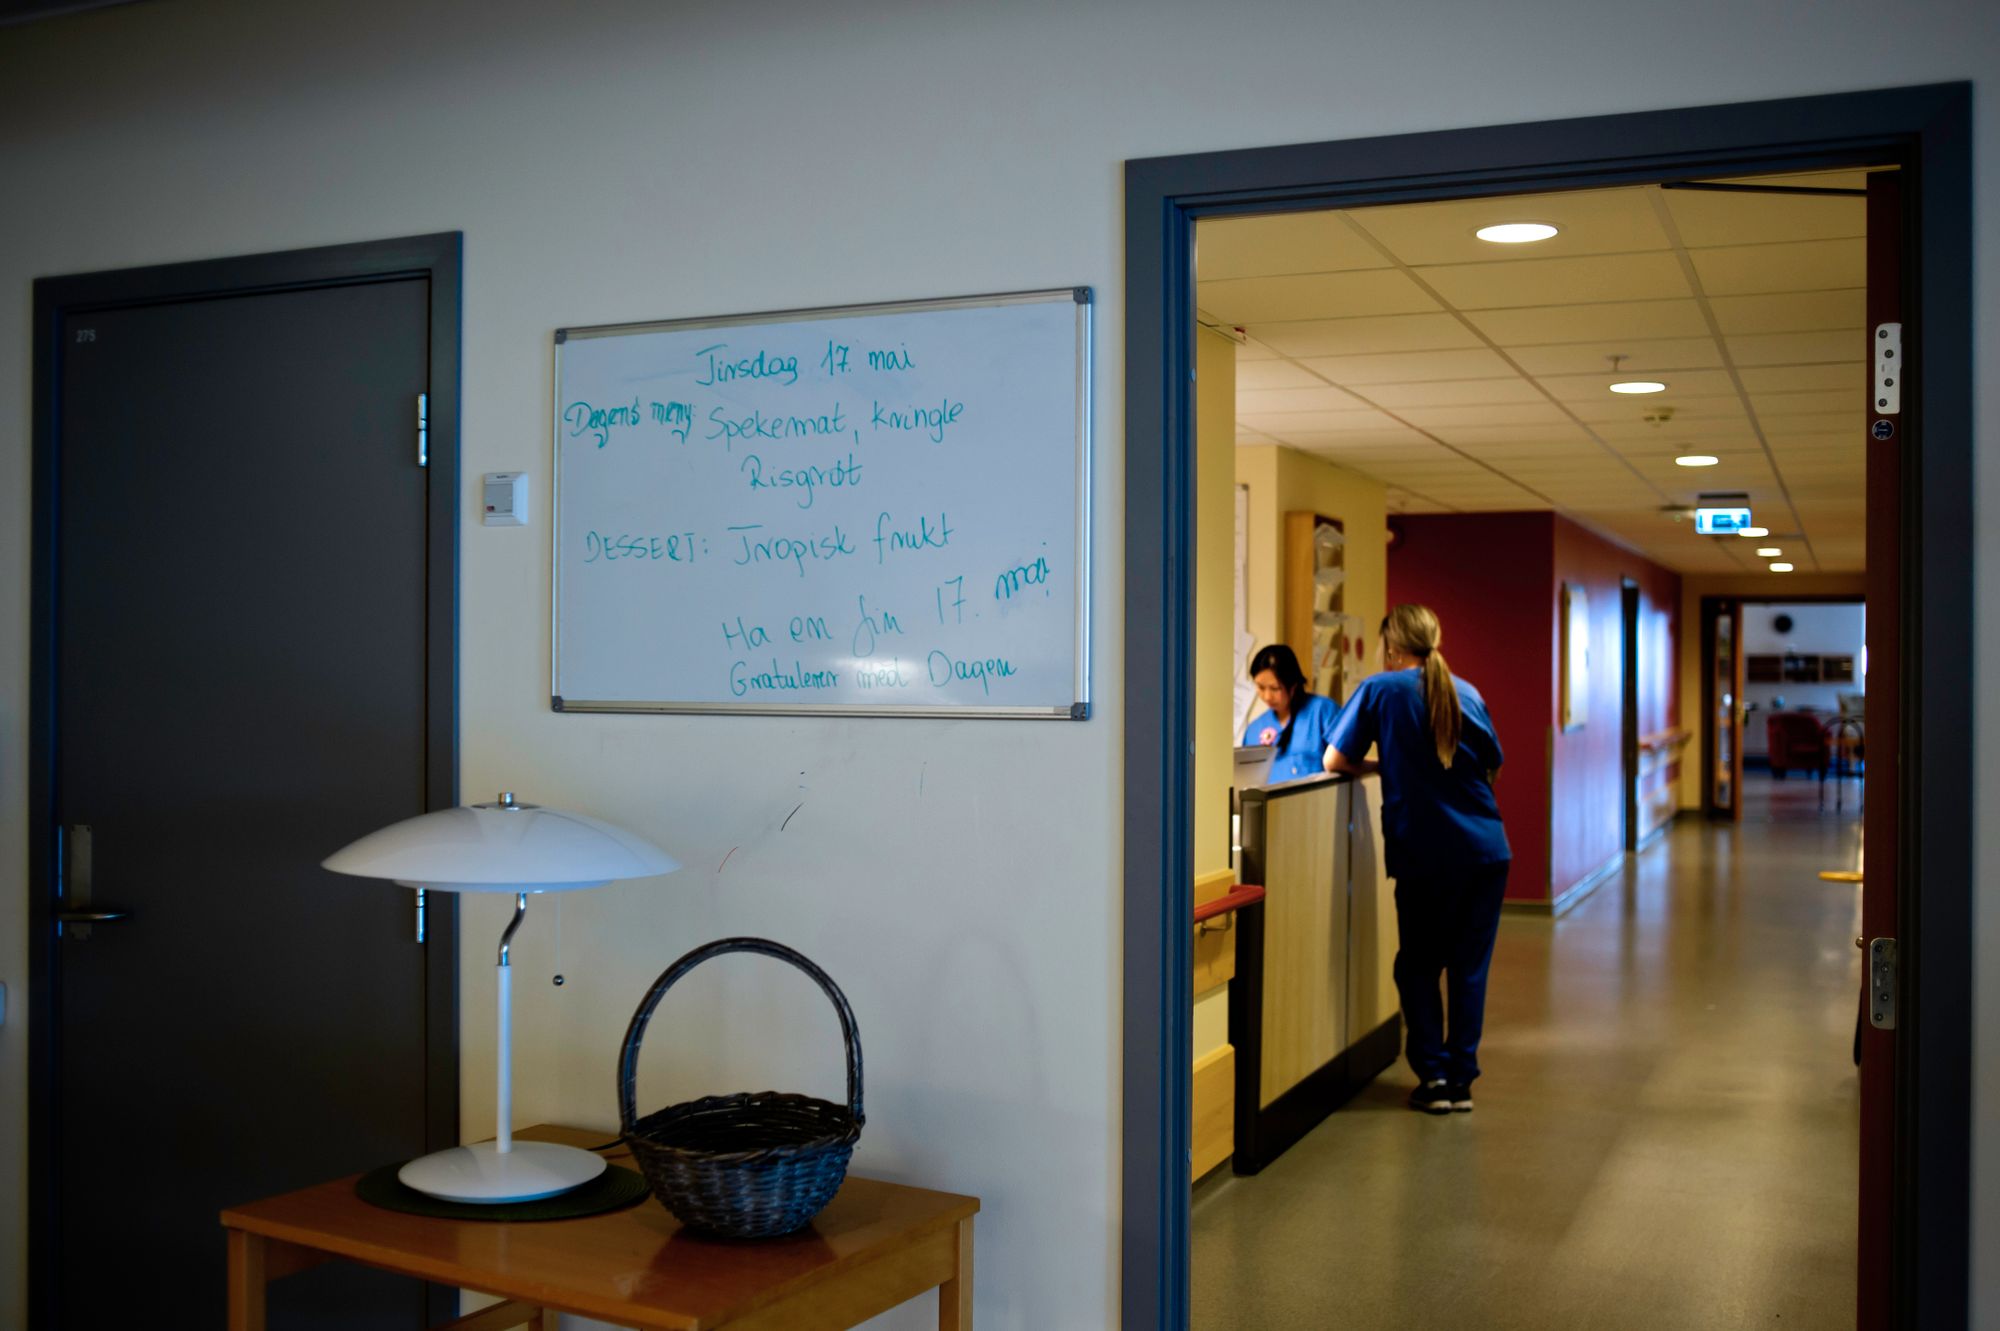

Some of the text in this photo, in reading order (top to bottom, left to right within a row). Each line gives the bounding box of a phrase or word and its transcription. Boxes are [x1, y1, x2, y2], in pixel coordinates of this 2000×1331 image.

[694, 343, 800, 387] Tirsdag
[867, 342, 916, 373] mai
[585, 511, 955, 577] DESSERT: Tropisk frukt
[721, 615, 771, 653] Ha
[788, 614, 835, 642] en
[851, 593, 906, 657] fin
[855, 656, 910, 690] med
